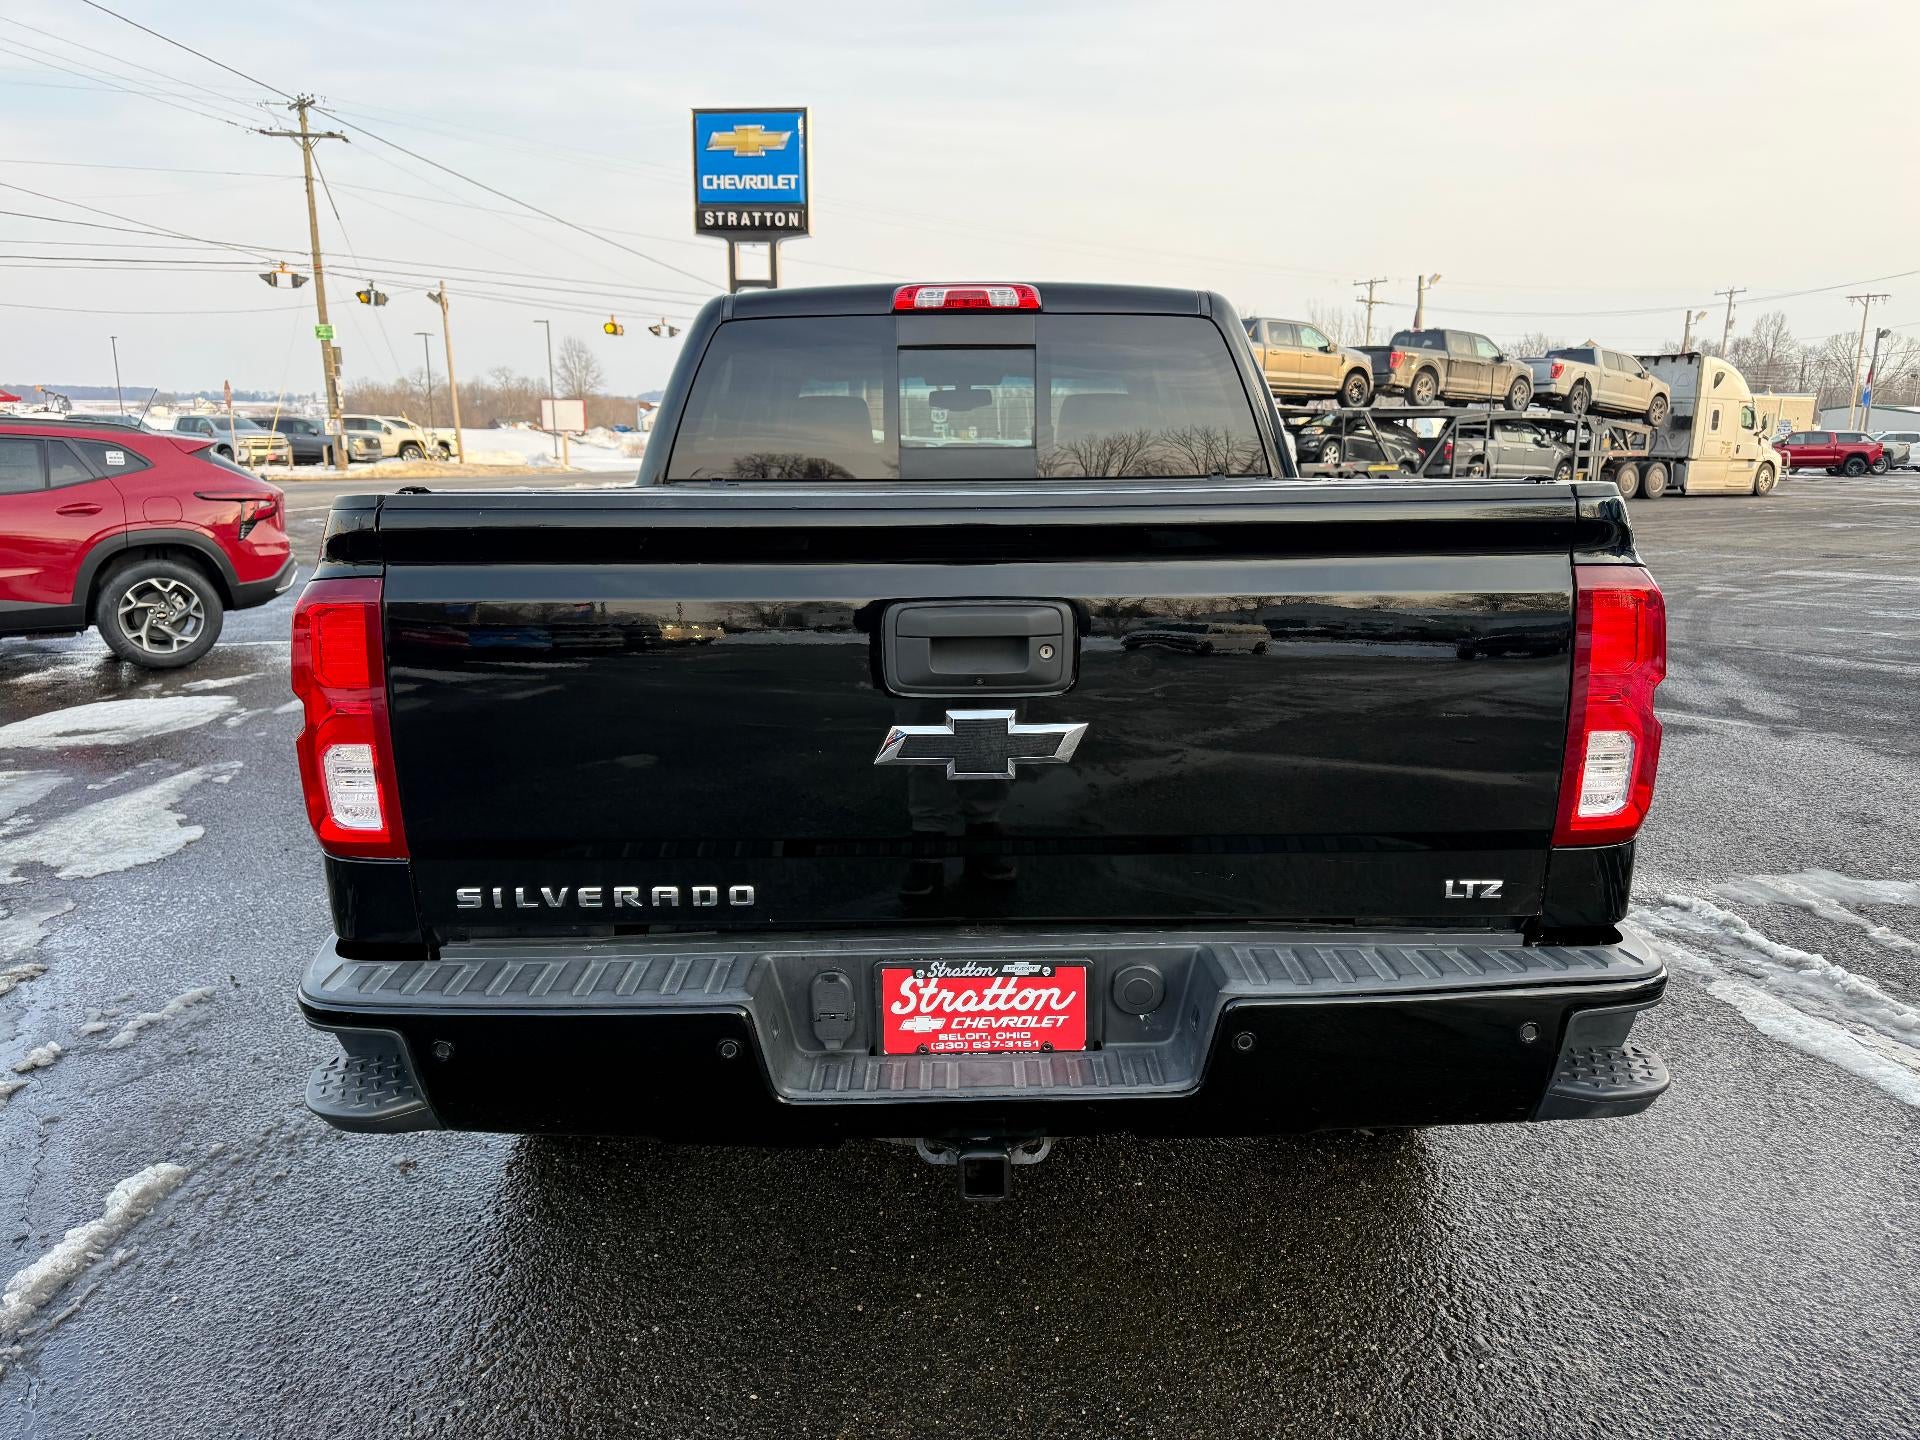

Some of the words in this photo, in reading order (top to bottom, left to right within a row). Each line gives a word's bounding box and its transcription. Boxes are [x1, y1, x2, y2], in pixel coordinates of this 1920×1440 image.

[702, 174, 798, 190] CHEVROLET
[704, 210, 799, 227] STRATTON
[456, 885, 755, 909] SILVERADO
[1444, 880, 1503, 899] LTZ
[927, 962, 998, 978] Stratton
[890, 976, 1076, 1014] Stratton
[951, 1016, 1069, 1029] CHEVROLET
[938, 1032, 991, 1041] BELOIT,
[995, 1031, 1031, 1040] OHIO
[930, 1041, 969, 1050] (330)
[972, 1040, 1040, 1049] 537-3151
